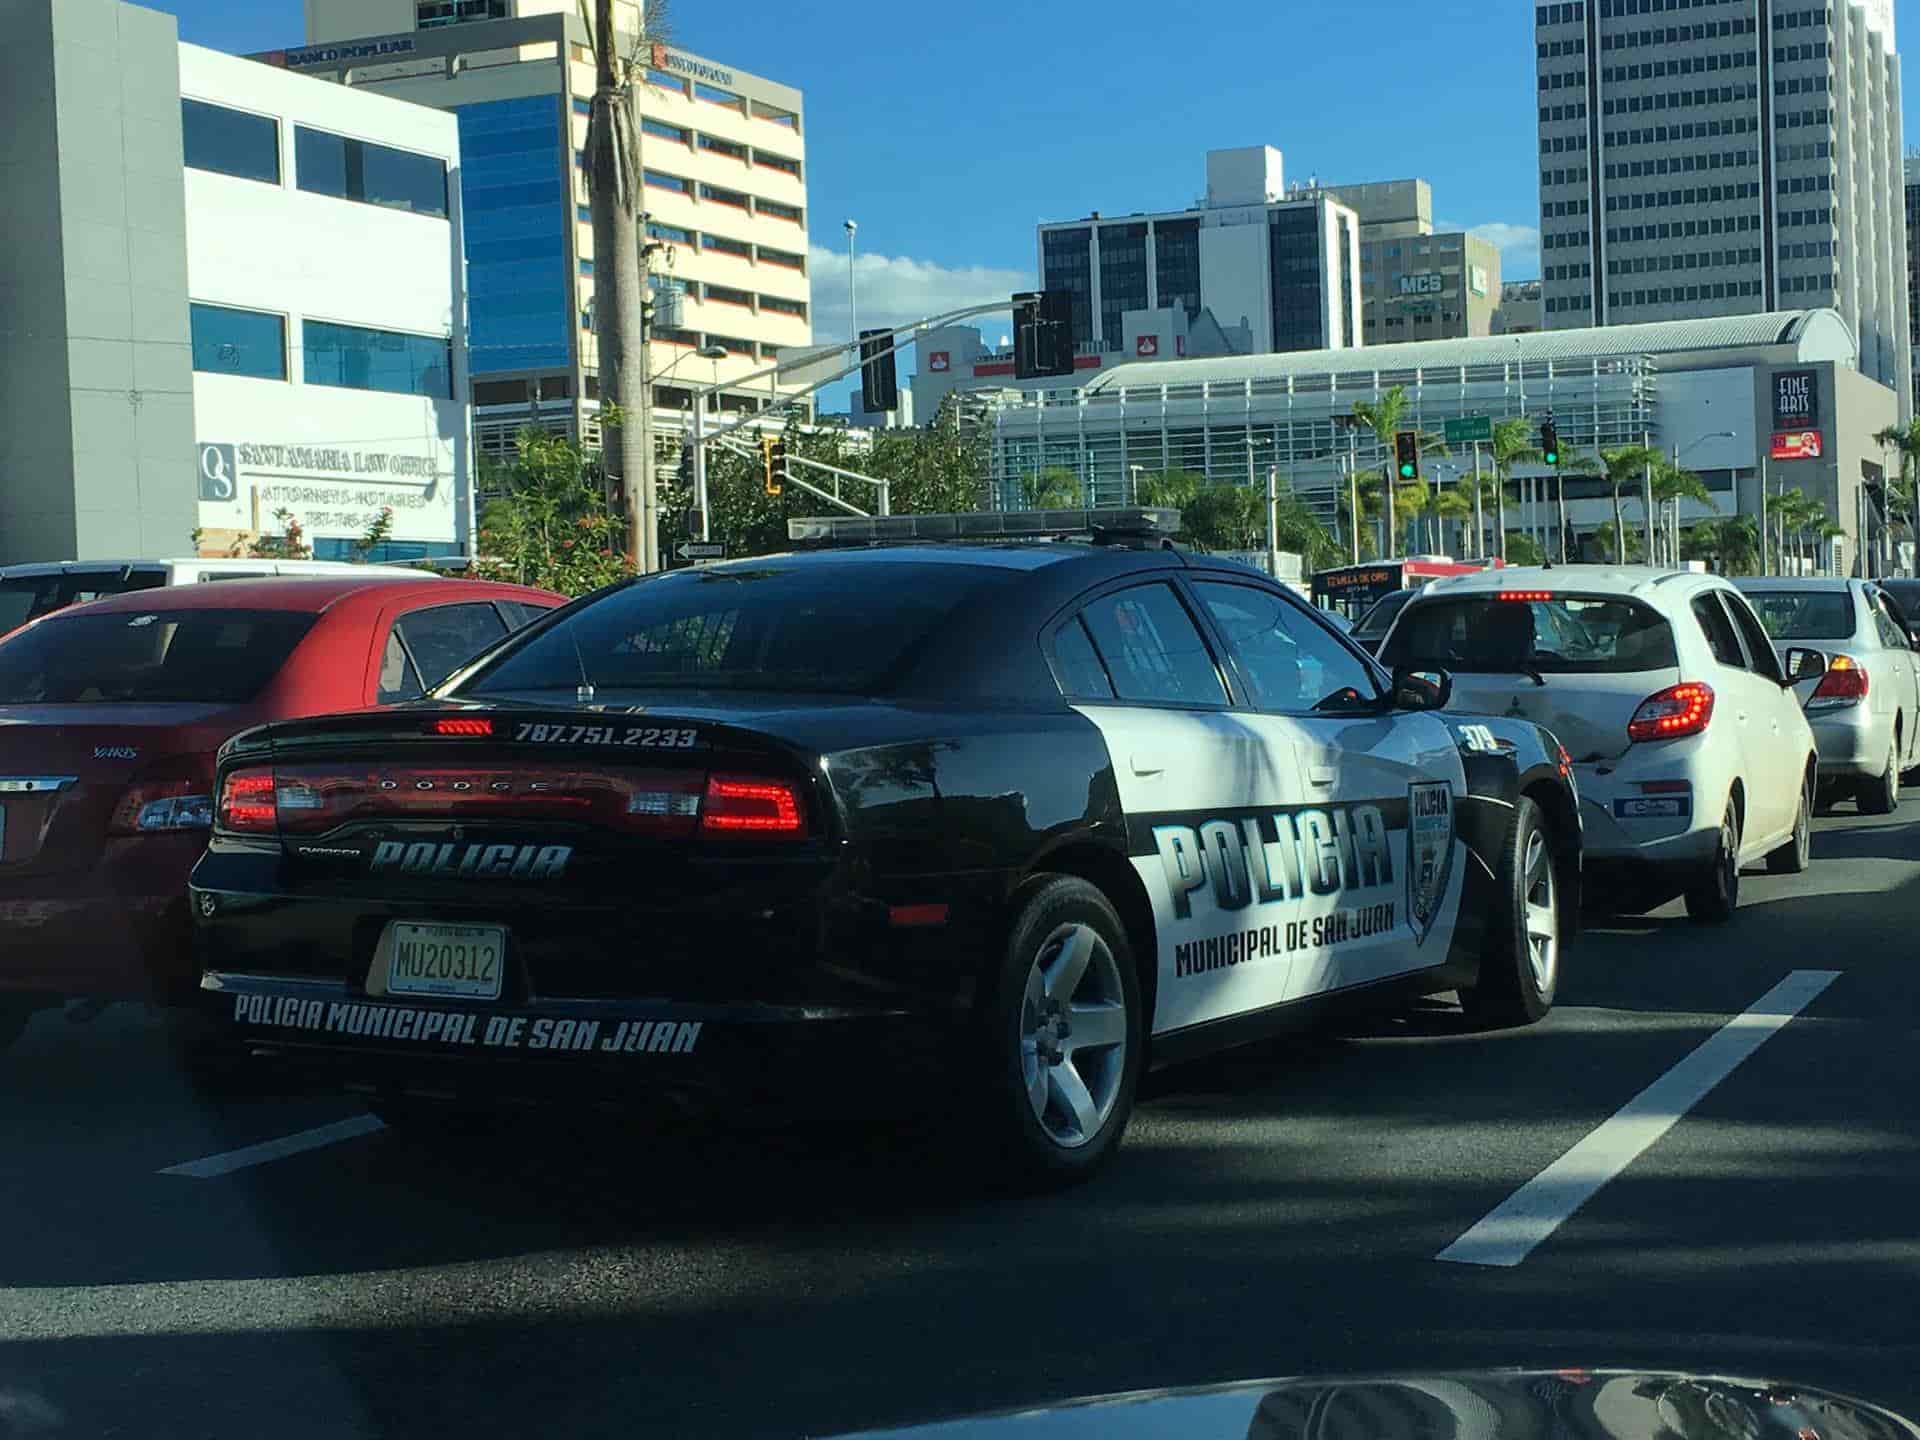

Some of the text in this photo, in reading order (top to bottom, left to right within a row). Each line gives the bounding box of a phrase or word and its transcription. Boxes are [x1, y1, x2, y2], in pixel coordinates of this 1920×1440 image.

[1400, 274, 1442, 294] MCS
[1779, 376, 1809, 395] FINE
[1779, 394, 1809, 413] ARTS
[514, 722, 698, 748] 787.751.2233
[1457, 724, 1497, 751] 379
[370, 840, 574, 878] POLICIA
[1151, 804, 1395, 920] POLICIA
[1174, 901, 1396, 979] MUNICIPAL DE SAN JUAN
[395, 941, 496, 982] MU20312
[234, 994, 704, 1053] POLICIA MUNICIPAL DE SAN JUAN
